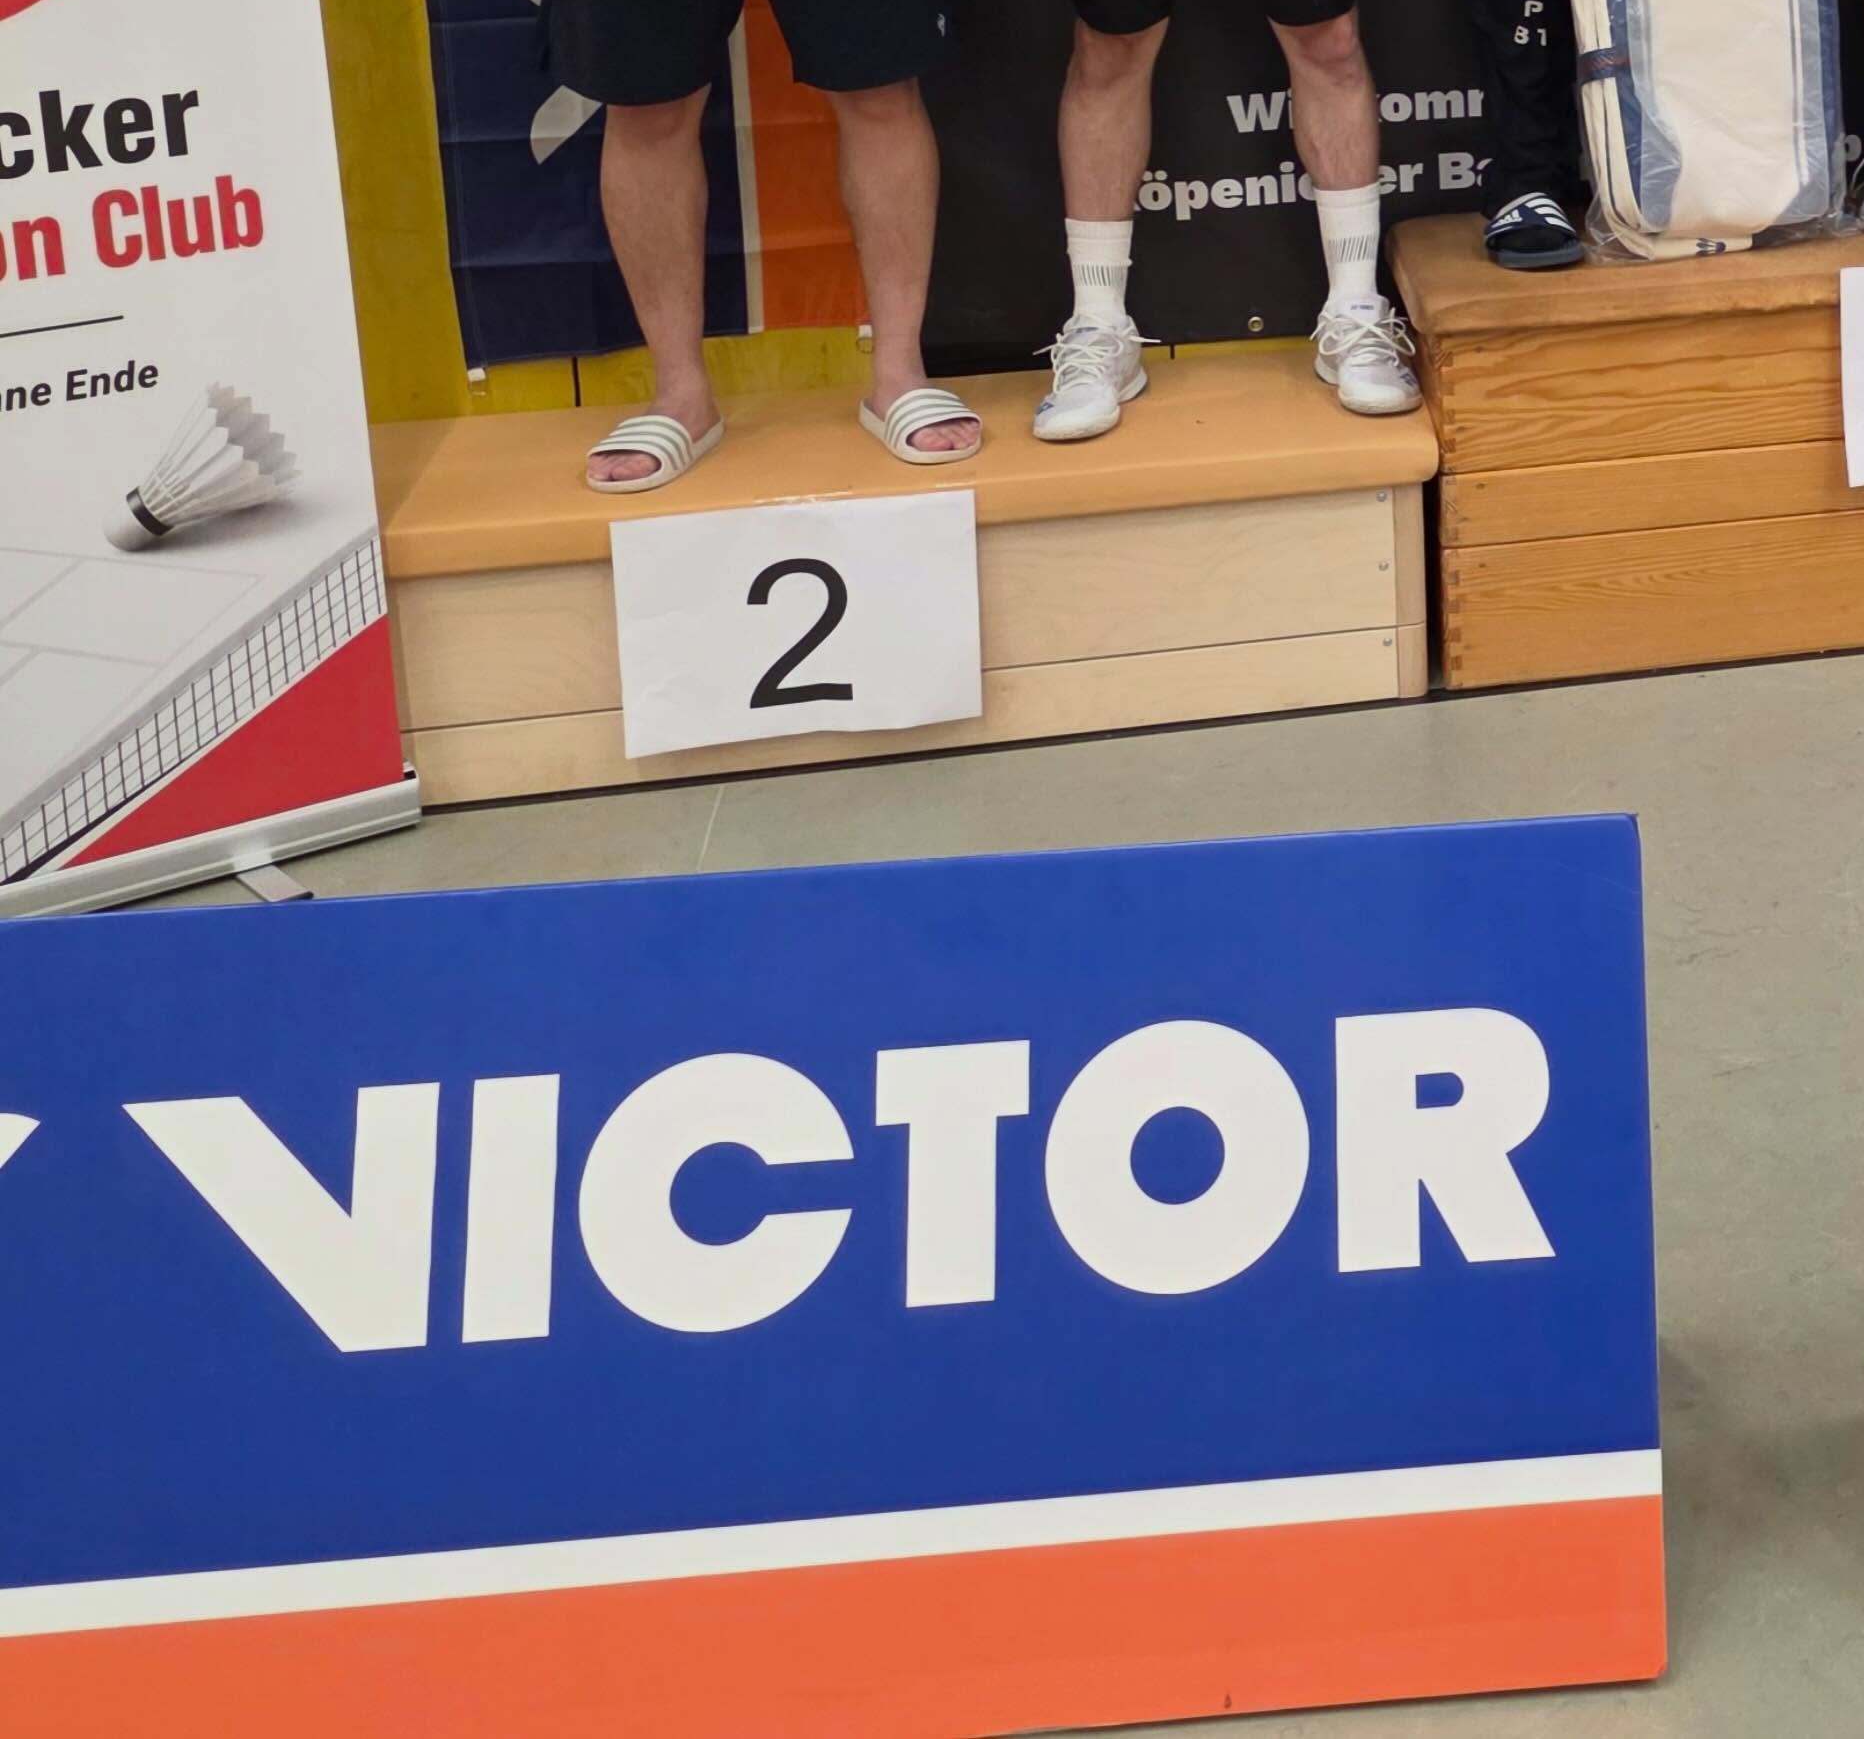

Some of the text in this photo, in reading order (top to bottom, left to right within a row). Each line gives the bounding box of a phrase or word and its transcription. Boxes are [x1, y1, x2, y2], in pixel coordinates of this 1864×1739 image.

[92, 174, 264, 270] Club
[0, 360, 159, 412] ne Ende
[746, 557, 854, 709] 2
[122, 1006, 1556, 1354] VICTOR
